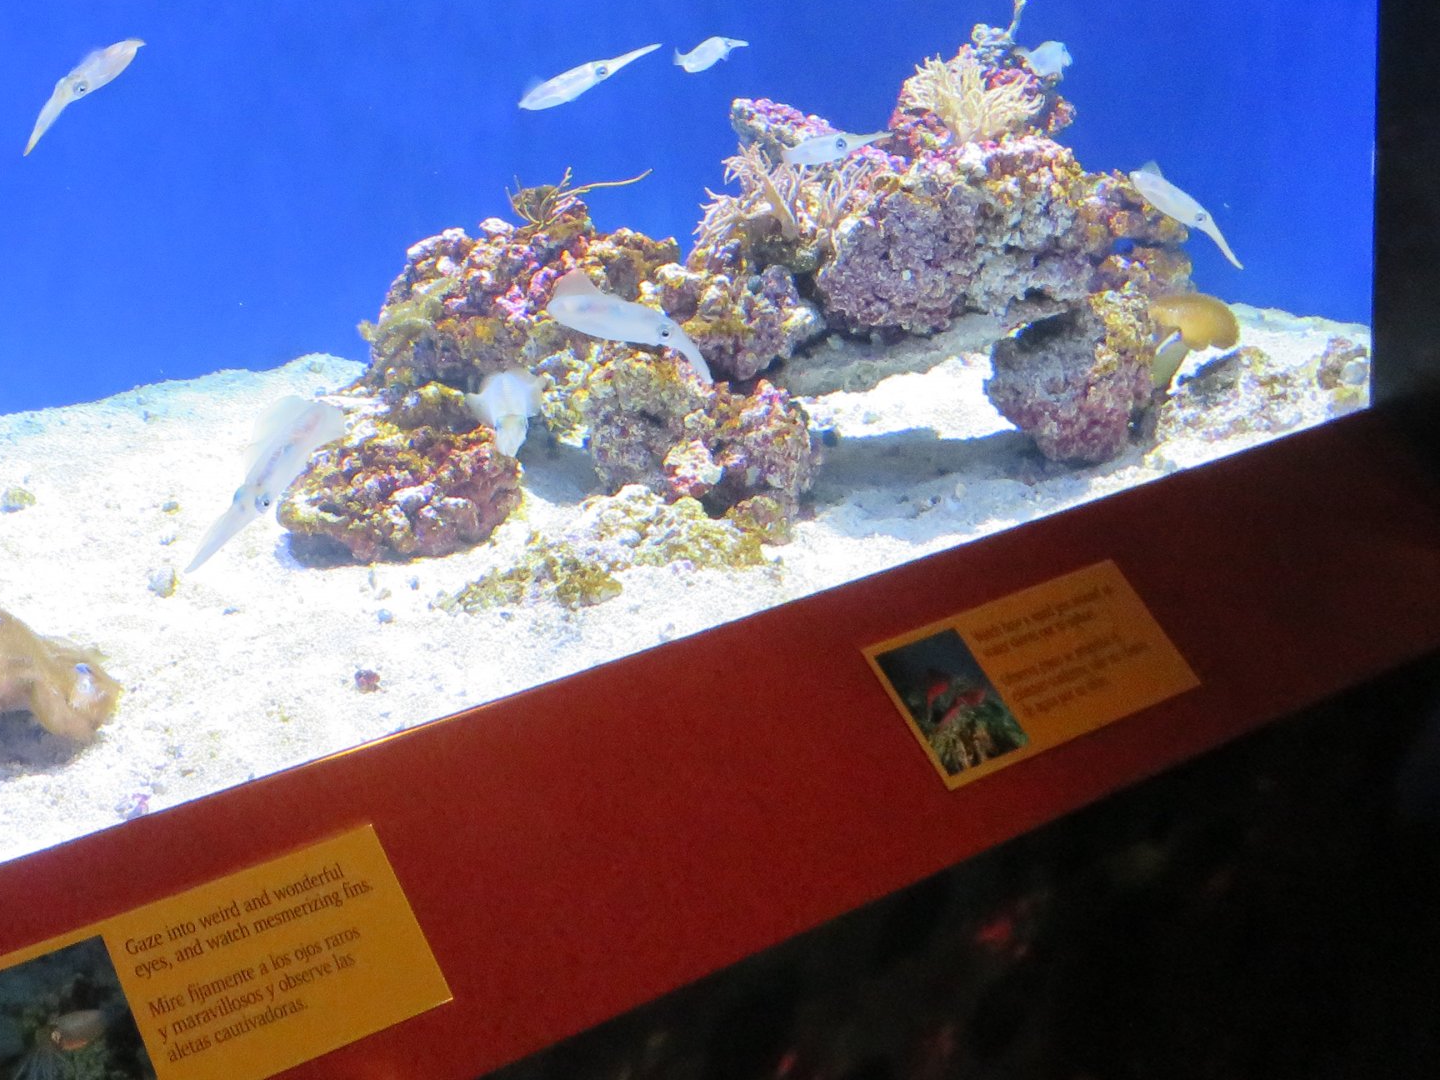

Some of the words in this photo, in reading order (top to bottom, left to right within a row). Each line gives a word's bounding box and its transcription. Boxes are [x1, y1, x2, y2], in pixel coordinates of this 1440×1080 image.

[126, 933, 162, 955] Gaze
[166, 920, 196, 941] into
[198, 902, 240, 929] weird
[244, 889, 271, 913] and
[273, 862, 344, 901] wonderful
[135, 955, 173, 980] eyes,
[176, 938, 204, 963] and
[206, 923, 250, 951] watch
[254, 888, 344, 931] mesmerizing
[344, 879, 373, 900] fins.
[148, 992, 184, 1018] Mire
[188, 966, 254, 1002] fijamente
[260, 960, 268, 976] a
[272, 951, 292, 970] los
[294, 942, 322, 966] ojos
[324, 926, 360, 951] raros
[158, 1026, 168, 1044] y
[172, 989, 264, 1035] maravillosos
[266, 983, 275, 1000] y
[279, 960, 333, 992] observe
[336, 951, 356, 970] las
[169, 1034, 212, 1062] aletas
[214, 996, 308, 1044] cautivadoras.
